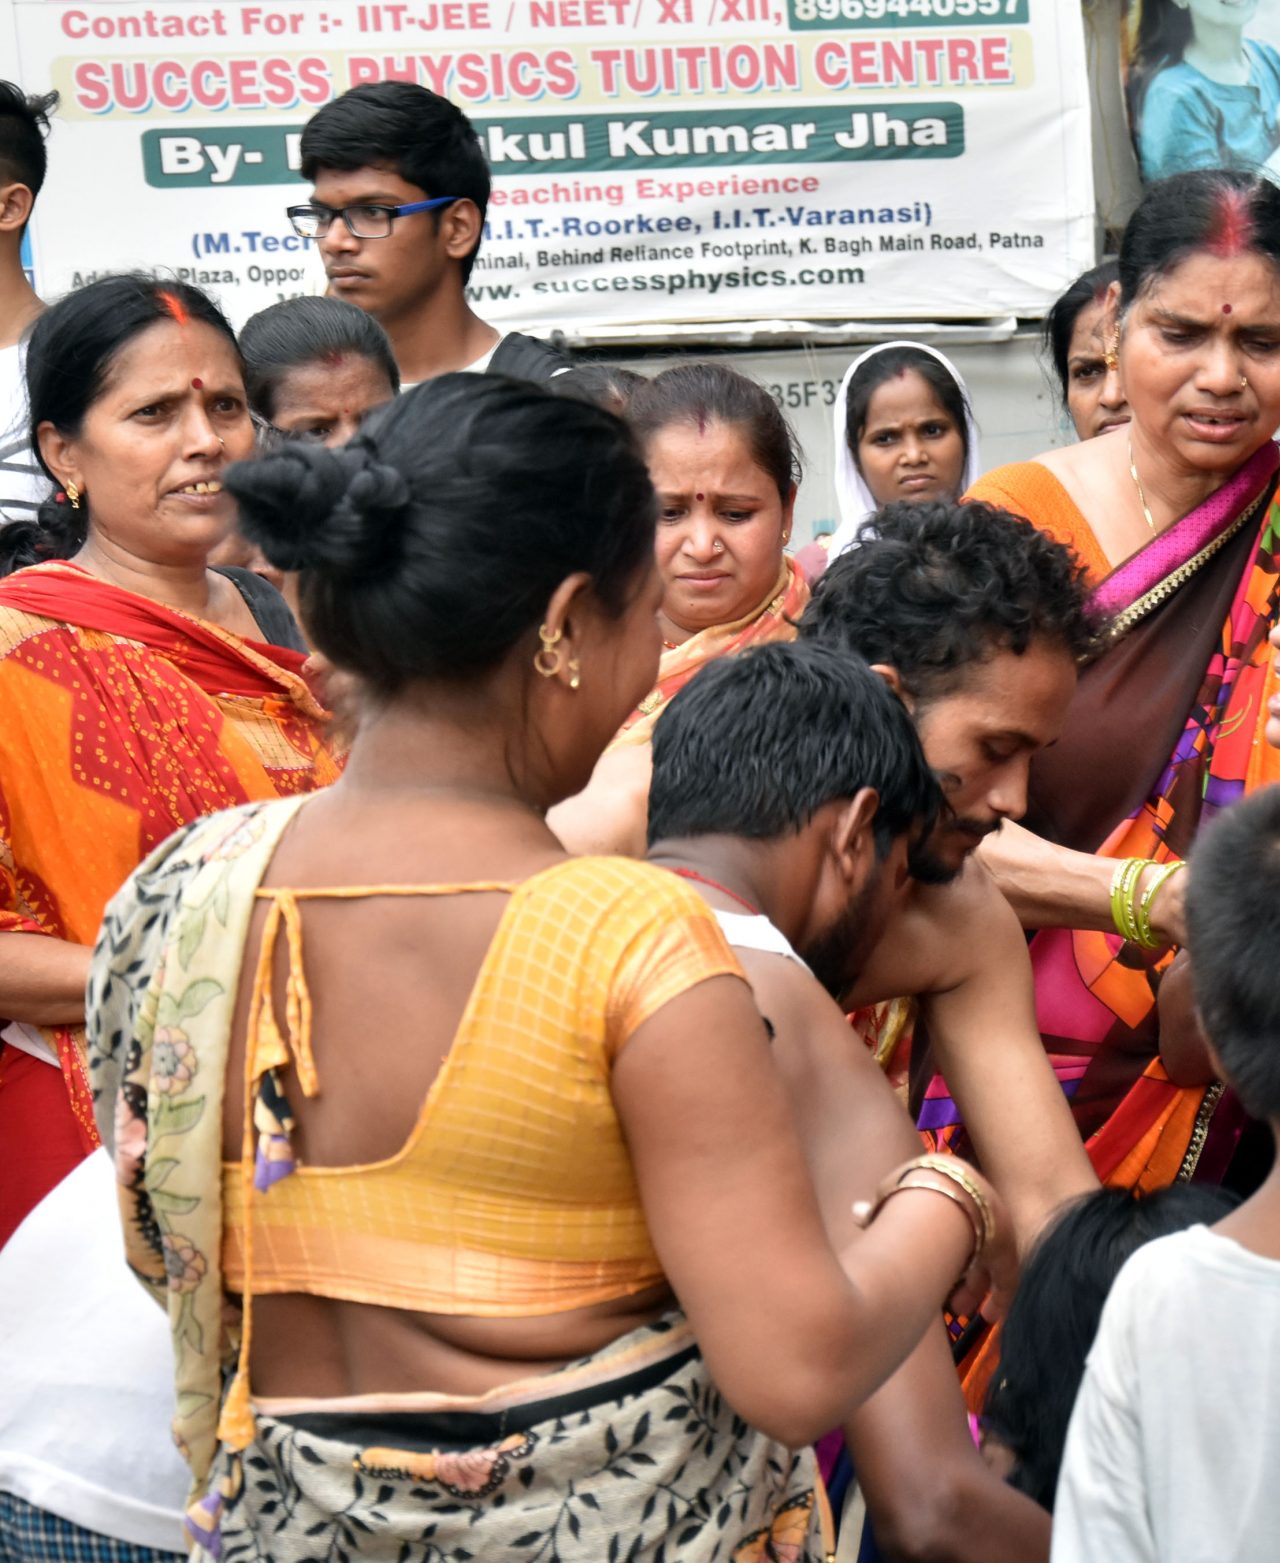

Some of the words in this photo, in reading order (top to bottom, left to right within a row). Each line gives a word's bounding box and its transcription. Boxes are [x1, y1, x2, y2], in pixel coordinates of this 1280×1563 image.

[61, 6, 227, 39] Contact
[241, 7, 305, 36] For
[358, 0, 491, 33] IIT-JEE
[74, 56, 332, 111] SUCCESS
[348, 49, 578, 99] PHYSICS
[592, 43, 797, 93] TUITION
[815, 37, 1012, 87] CENTRE
[159, 135, 264, 184] By-
[478, 122, 587, 164] kul
[607, 116, 817, 159] Kumar
[835, 111, 949, 149] Jha
[490, 181, 625, 206] eaching
[637, 174, 819, 201] Experience
[713, 202, 933, 231] I.I.T.-Varanasi)
[474, 252, 530, 271] minal,
[537, 248, 605, 267] Behind
[611, 243, 694, 263] Reliance
[701, 237, 793, 261] Footprint,
[800, 239, 818, 256] K.
[825, 234, 873, 258] Bagh
[879, 231, 924, 252] Main
[930, 231, 984, 254] Road,
[990, 231, 1044, 251] Patna
[532, 263, 865, 296] successphysics.com
[770, 379, 843, 408] 35F3
